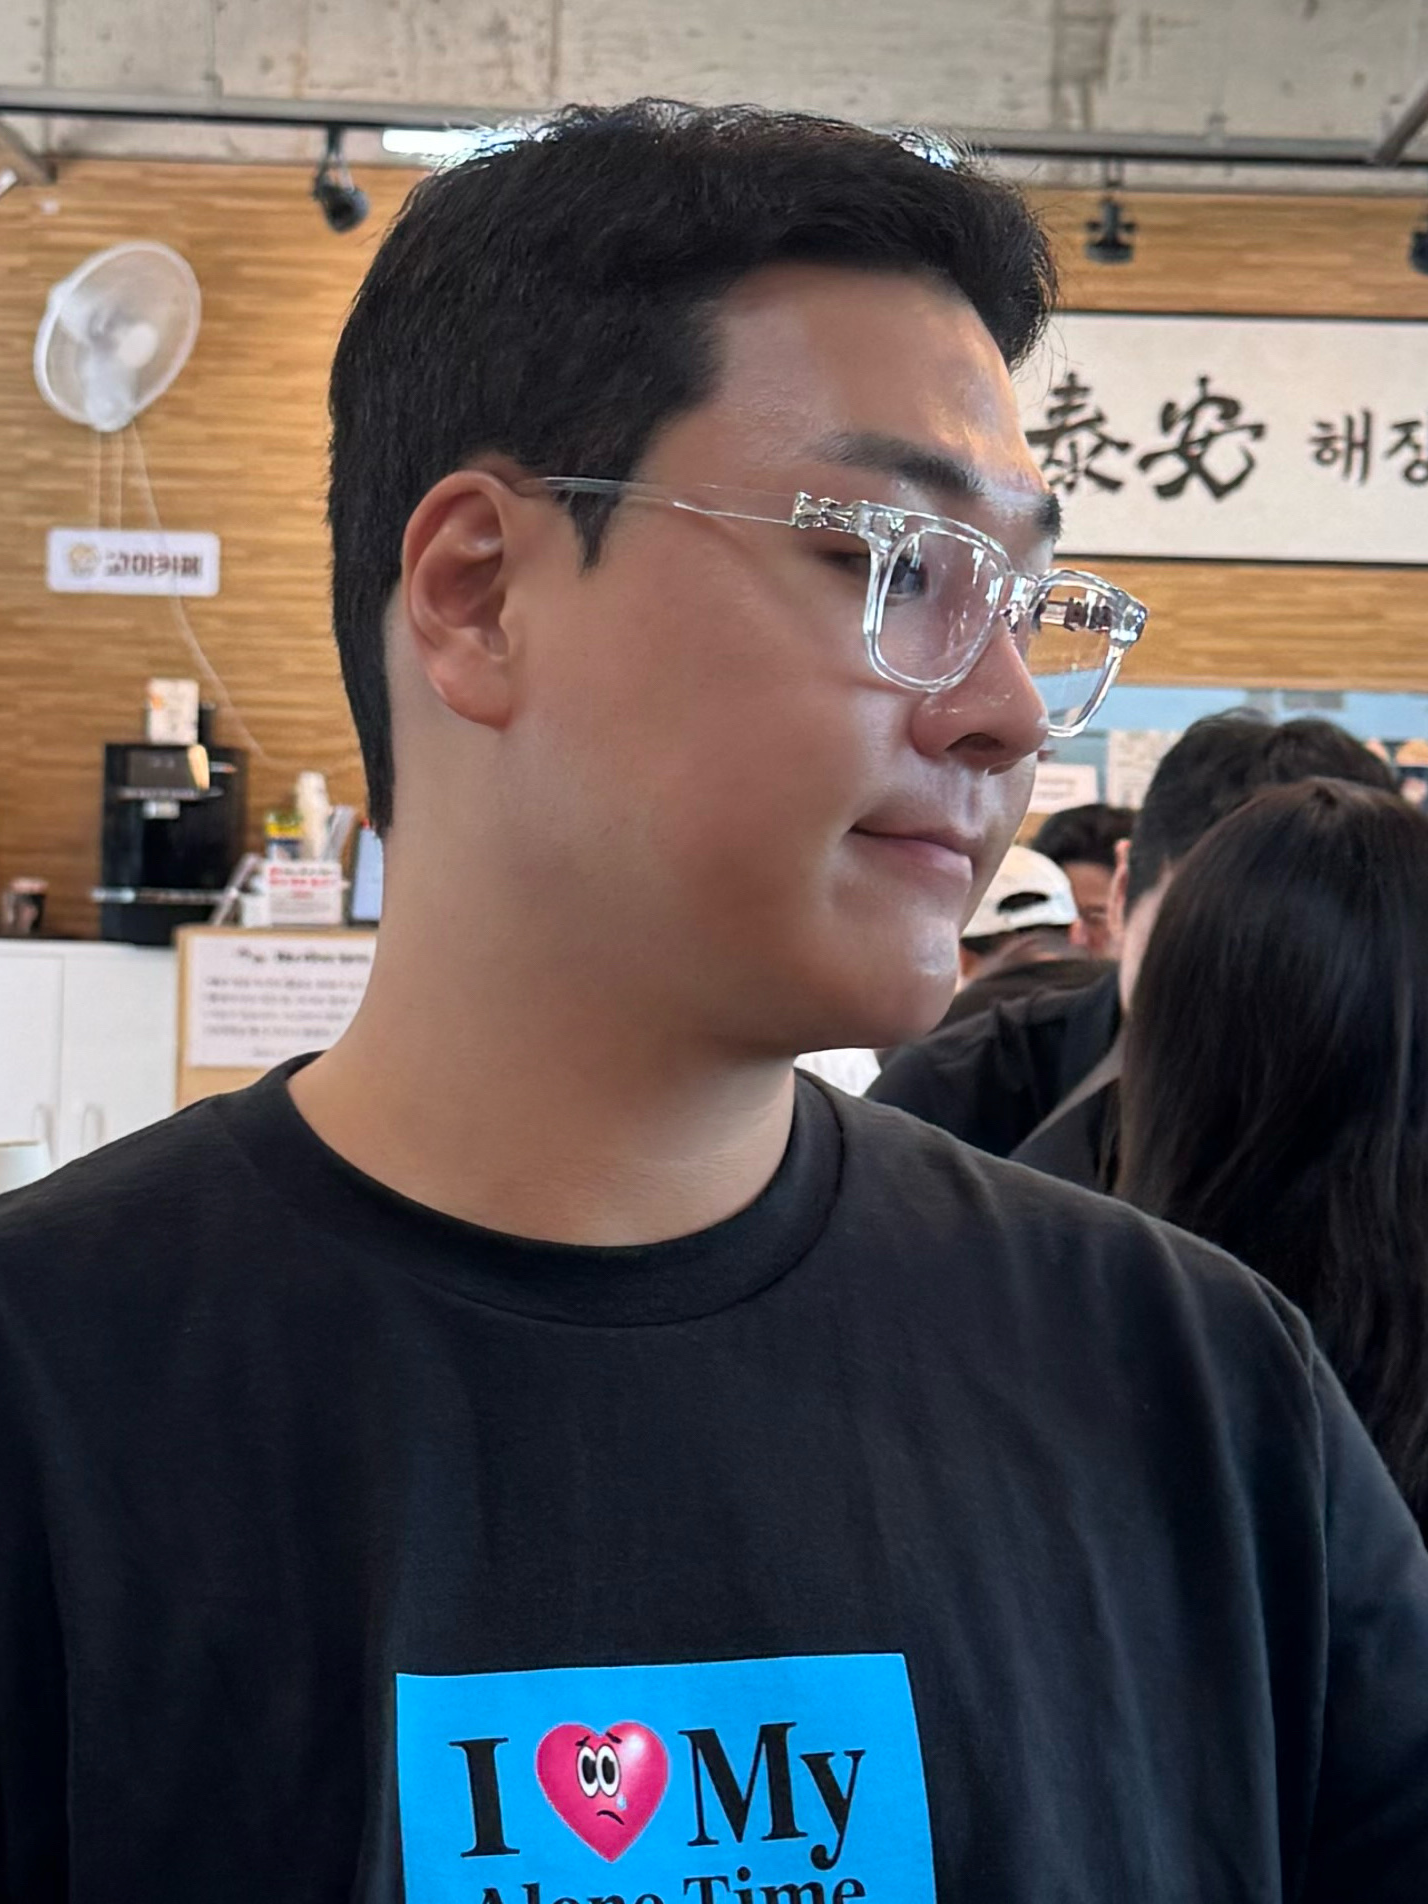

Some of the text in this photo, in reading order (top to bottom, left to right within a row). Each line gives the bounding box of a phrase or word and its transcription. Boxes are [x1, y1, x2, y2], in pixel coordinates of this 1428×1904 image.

[1026, 373, 1265, 504] 泰安
[448, 1721, 866, 1871] I My
